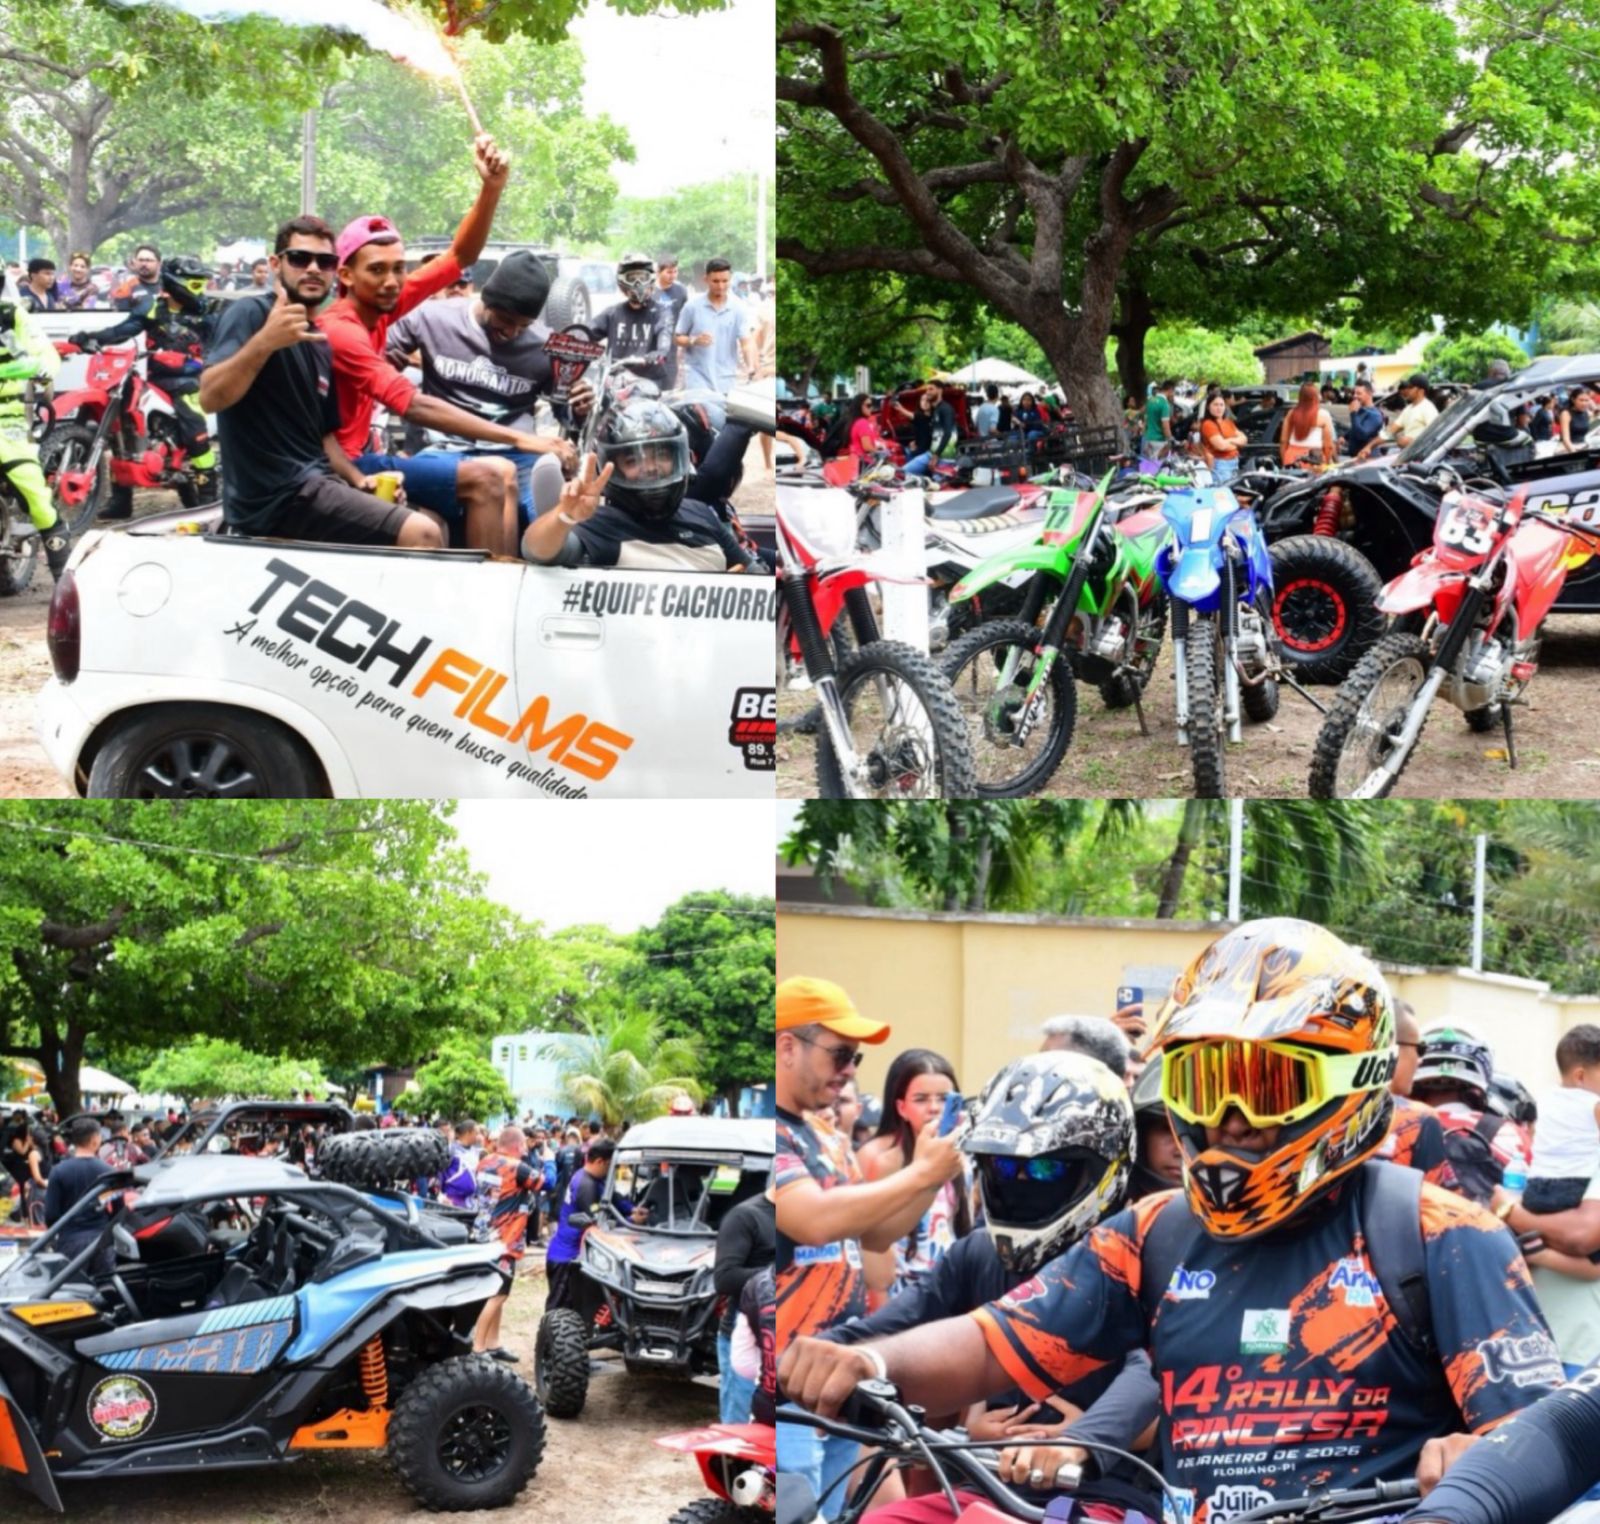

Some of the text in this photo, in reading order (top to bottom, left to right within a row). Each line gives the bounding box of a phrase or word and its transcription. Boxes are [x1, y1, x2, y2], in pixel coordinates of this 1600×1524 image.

[617, 323, 652, 341] FLY
[562, 580, 659, 617] #EQUIPE
[248, 557, 433, 688] TECH
[223, 618, 258, 645] A
[250, 634, 308, 670] melhor
[309, 665, 359, 698] opção
[355, 690, 406, 720] para
[405, 714, 454, 744] quem
[455, 732, 506, 766] busca
[411, 647, 635, 781] FILMS
[1223, 1378, 1355, 1411] RALLY
[1352, 1387, 1391, 1406] DA
[1213, 1463, 1297, 1477] FLORIANO-PI
[1273, 1449, 1299, 1460] DE
[1305, 1445, 1362, 1459] 2026
